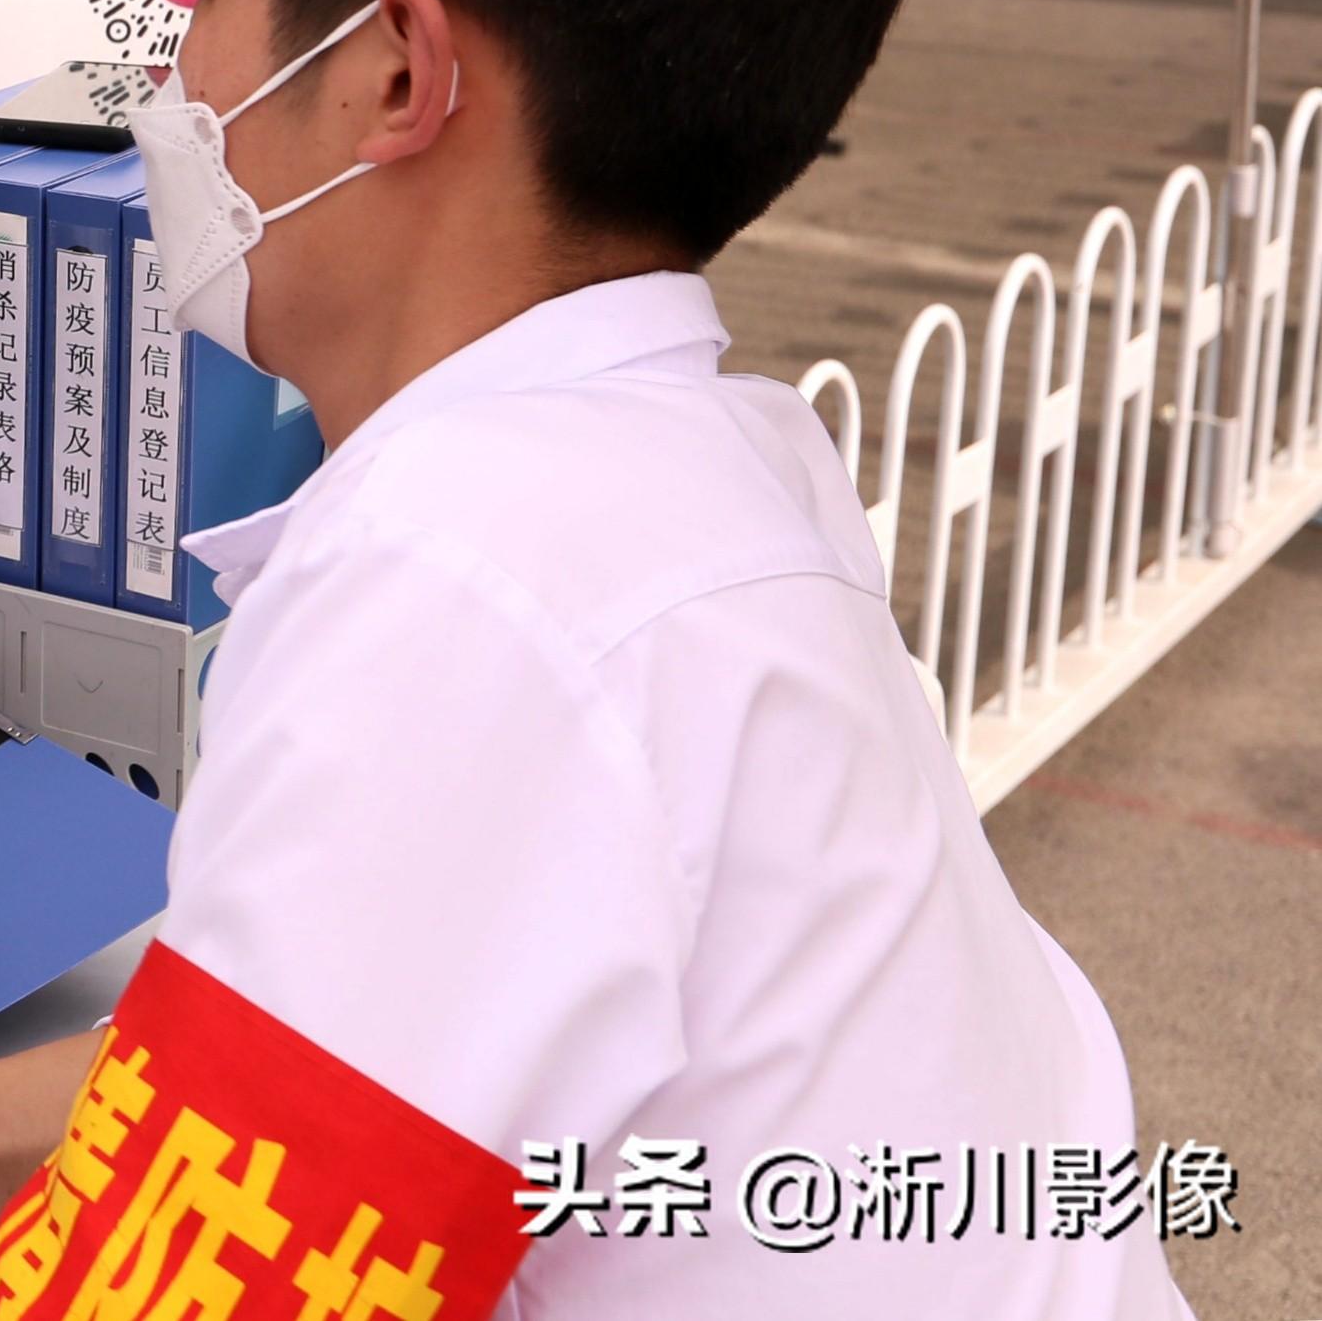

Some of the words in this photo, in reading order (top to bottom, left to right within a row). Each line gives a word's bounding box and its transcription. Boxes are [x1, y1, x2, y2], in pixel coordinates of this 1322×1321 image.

[61, 260, 96, 541] 防疫预案及制度
[135, 262, 172, 545] 员工信息登记表
